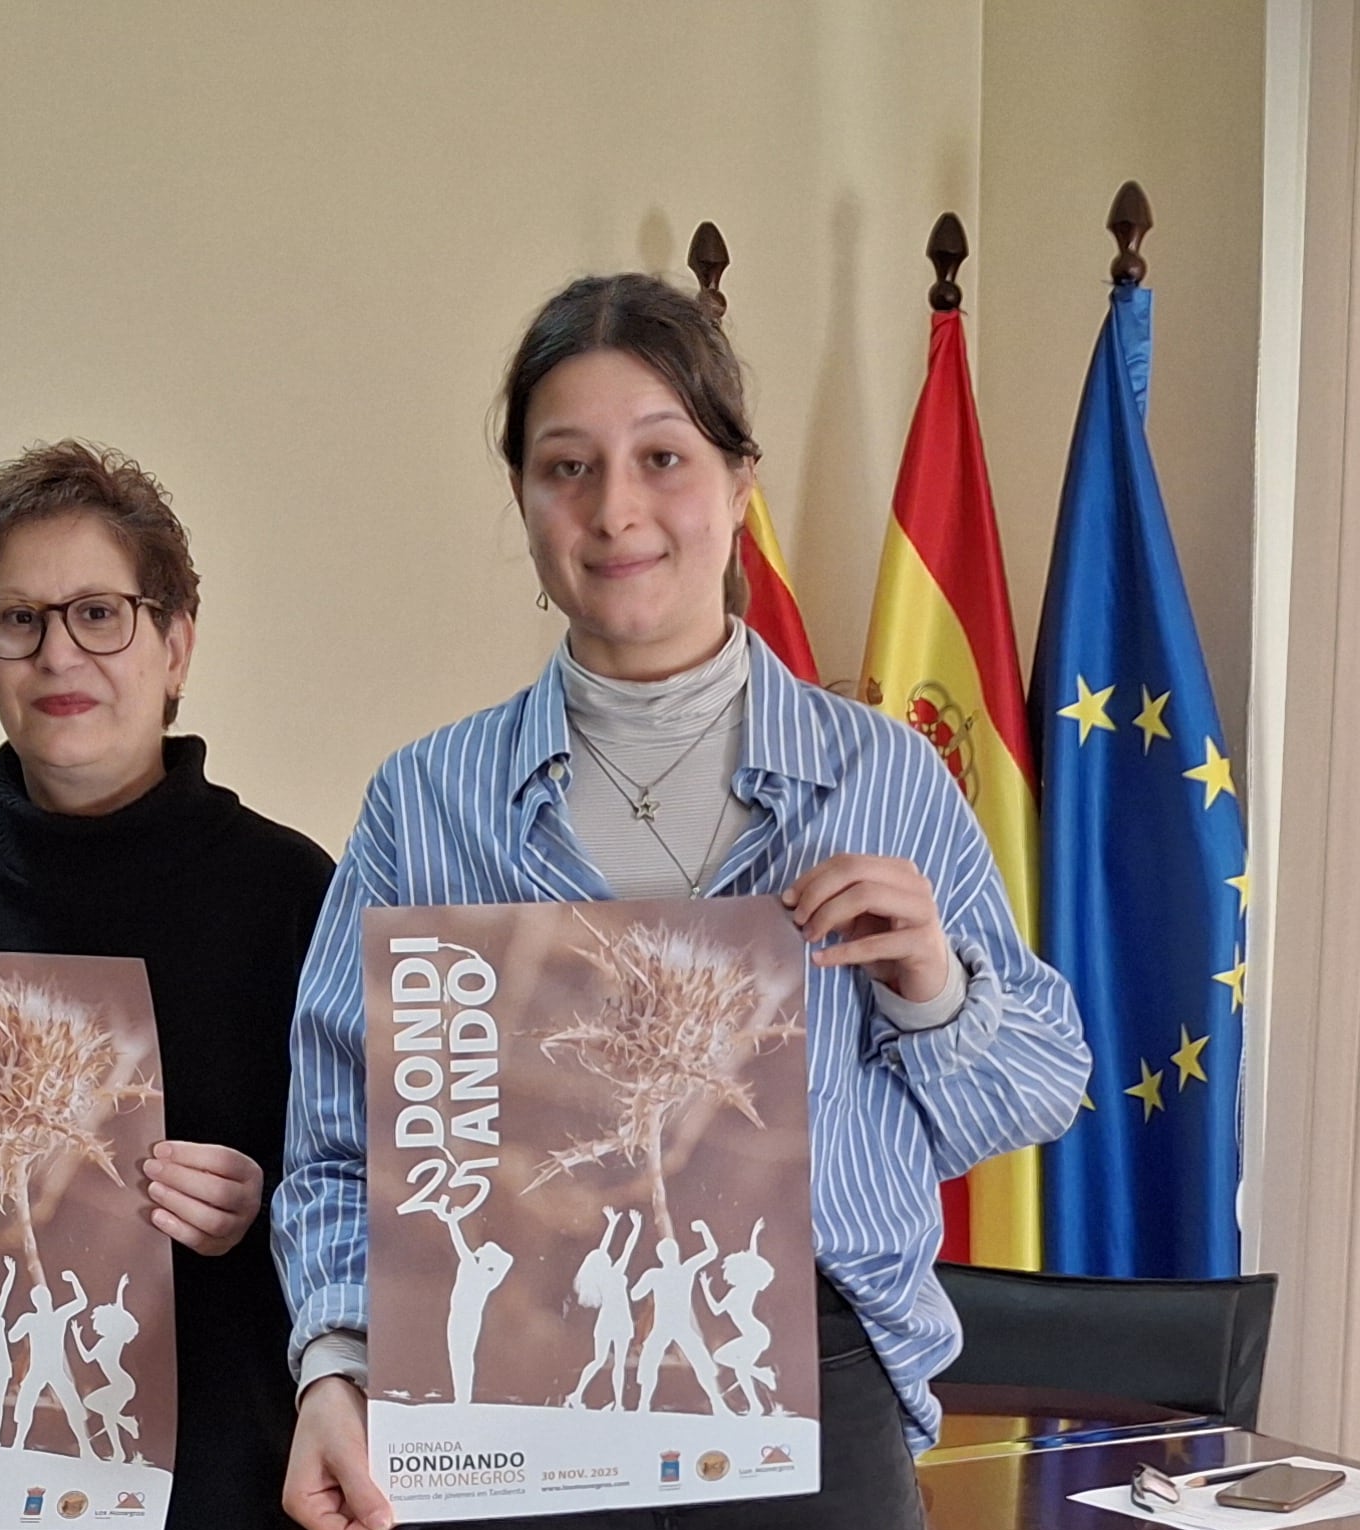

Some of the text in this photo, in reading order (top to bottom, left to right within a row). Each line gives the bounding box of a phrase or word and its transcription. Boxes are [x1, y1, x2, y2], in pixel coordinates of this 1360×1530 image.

[389, 936, 445, 1148] DONDI
[446, 959, 500, 1147] ANDO
[388, 1441, 463, 1454] II JORNADA
[390, 1452, 525, 1473] DONDIANDO
[390, 1469, 526, 1489] POR MONEGROS
[541, 1467, 618, 1481] 30 NOV. 2025
